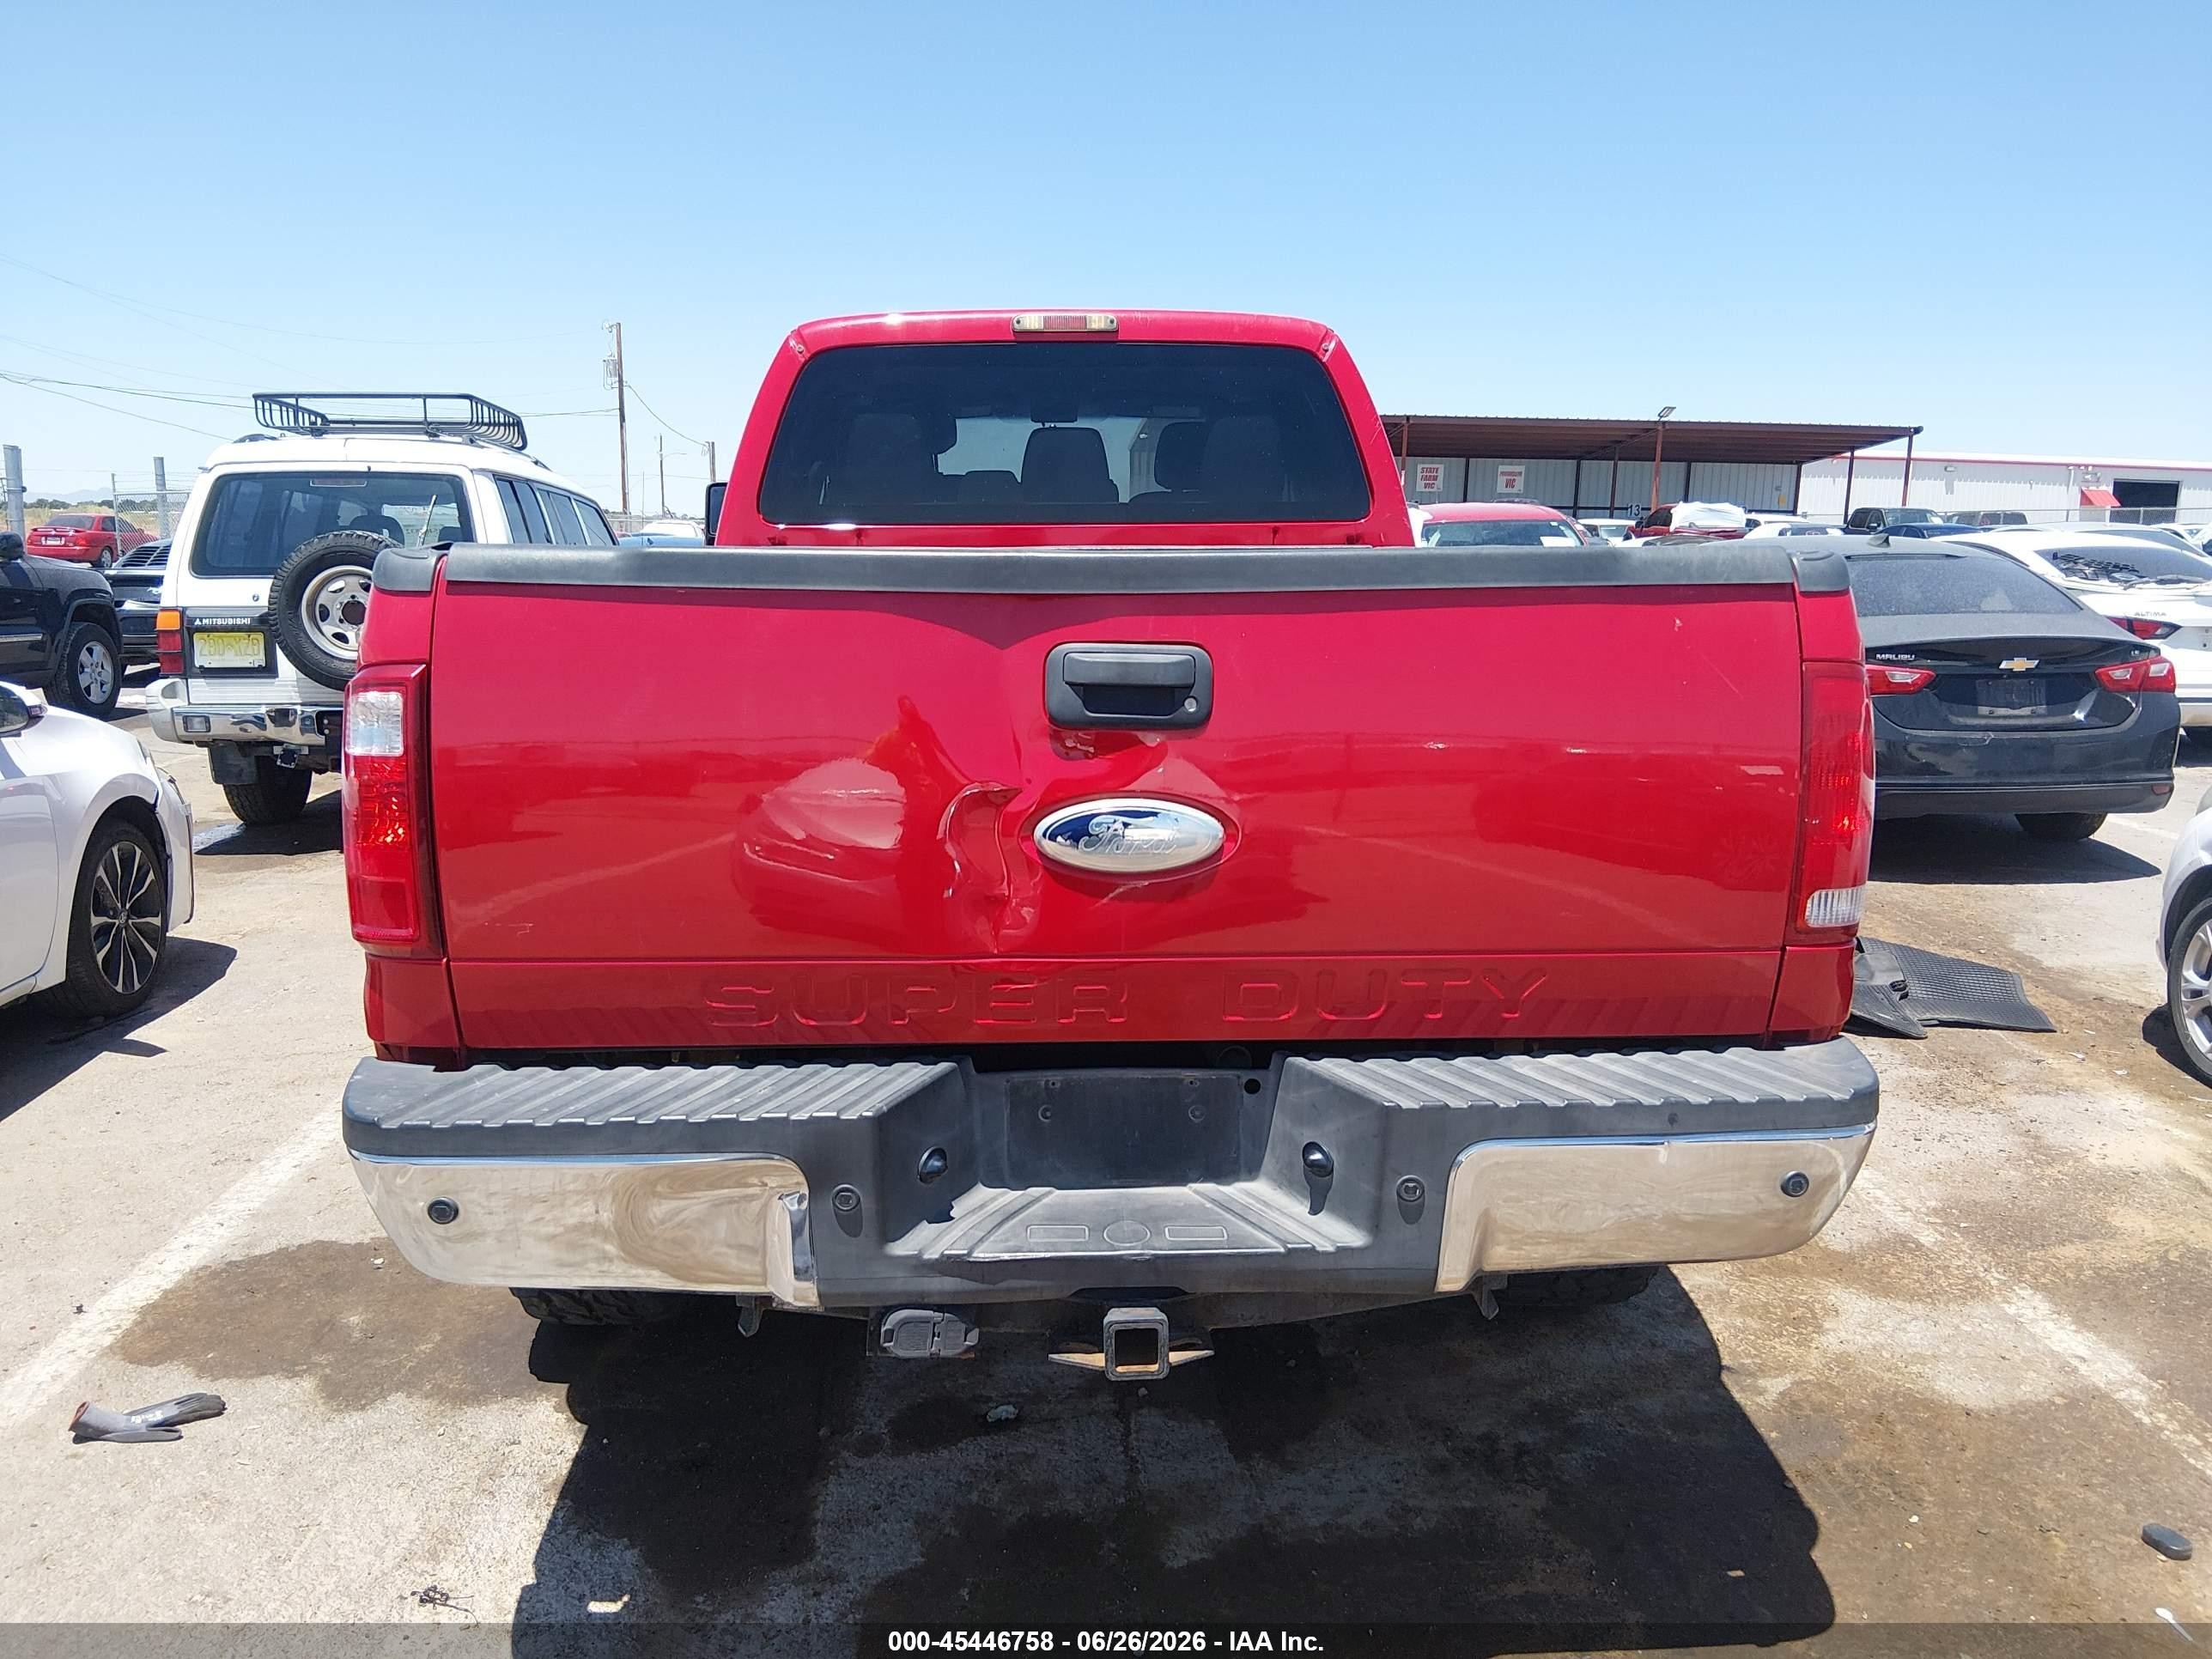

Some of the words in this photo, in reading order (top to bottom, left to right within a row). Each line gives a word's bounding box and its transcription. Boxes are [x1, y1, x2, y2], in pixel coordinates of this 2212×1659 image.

[1504, 478, 1516, 488] VIC
[1628, 504, 1640, 516] 13
[703, 975, 1127, 1026] SUPER
[1222, 969, 1547, 1021] DUTY
